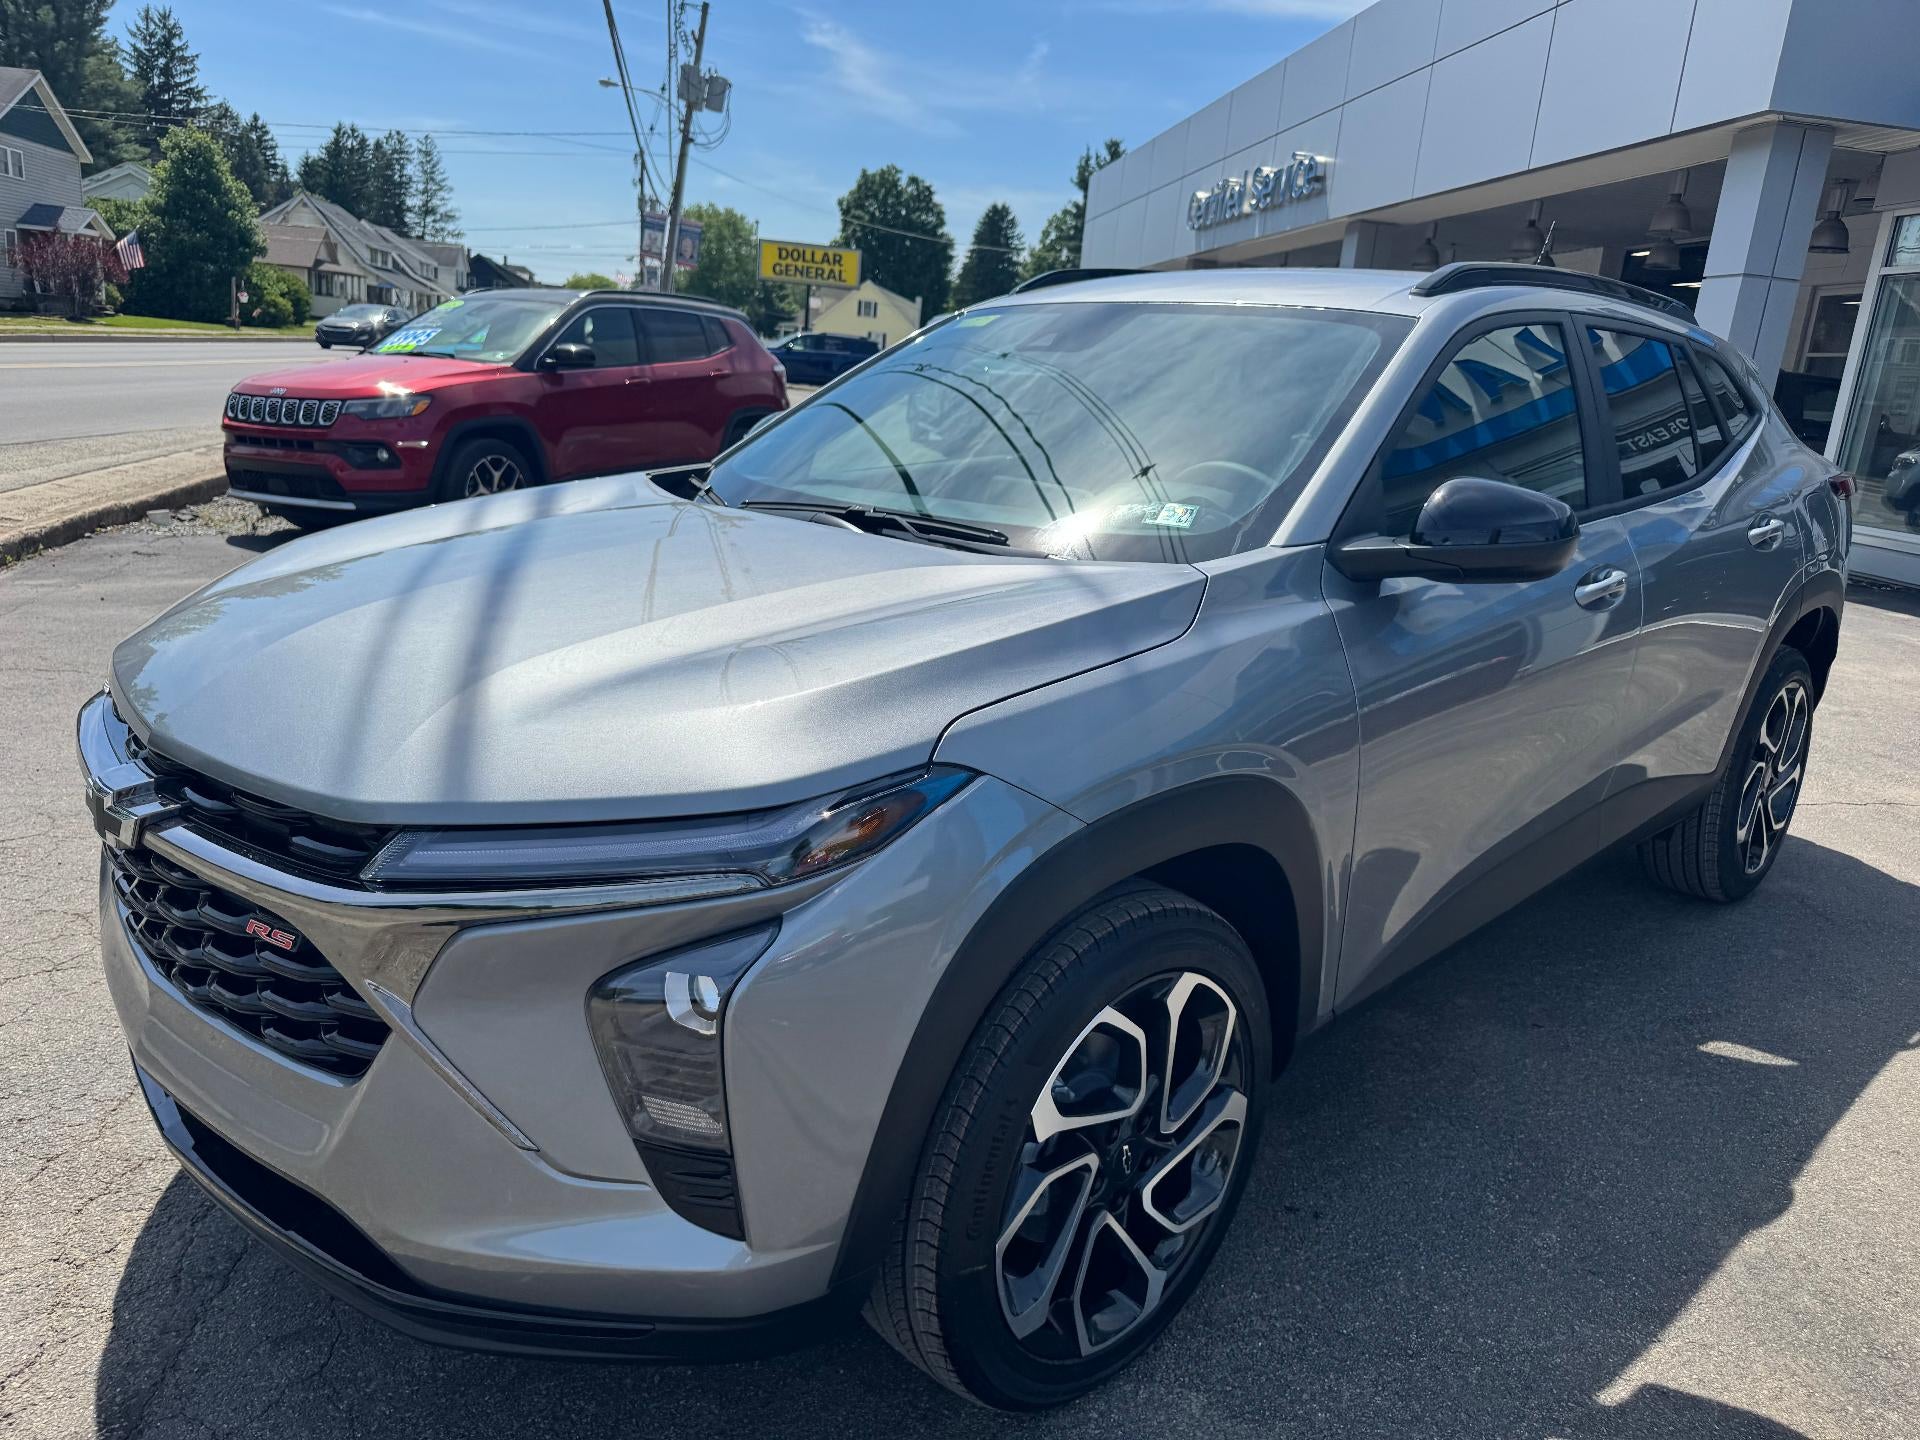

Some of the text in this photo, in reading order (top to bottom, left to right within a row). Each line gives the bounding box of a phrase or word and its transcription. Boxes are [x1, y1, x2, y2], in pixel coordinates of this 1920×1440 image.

[1250, 152, 1326, 211] Service
[777, 246, 844, 267] DOLLAR
[772, 262, 847, 283] GENERAL
[245, 919, 296, 951] RS
